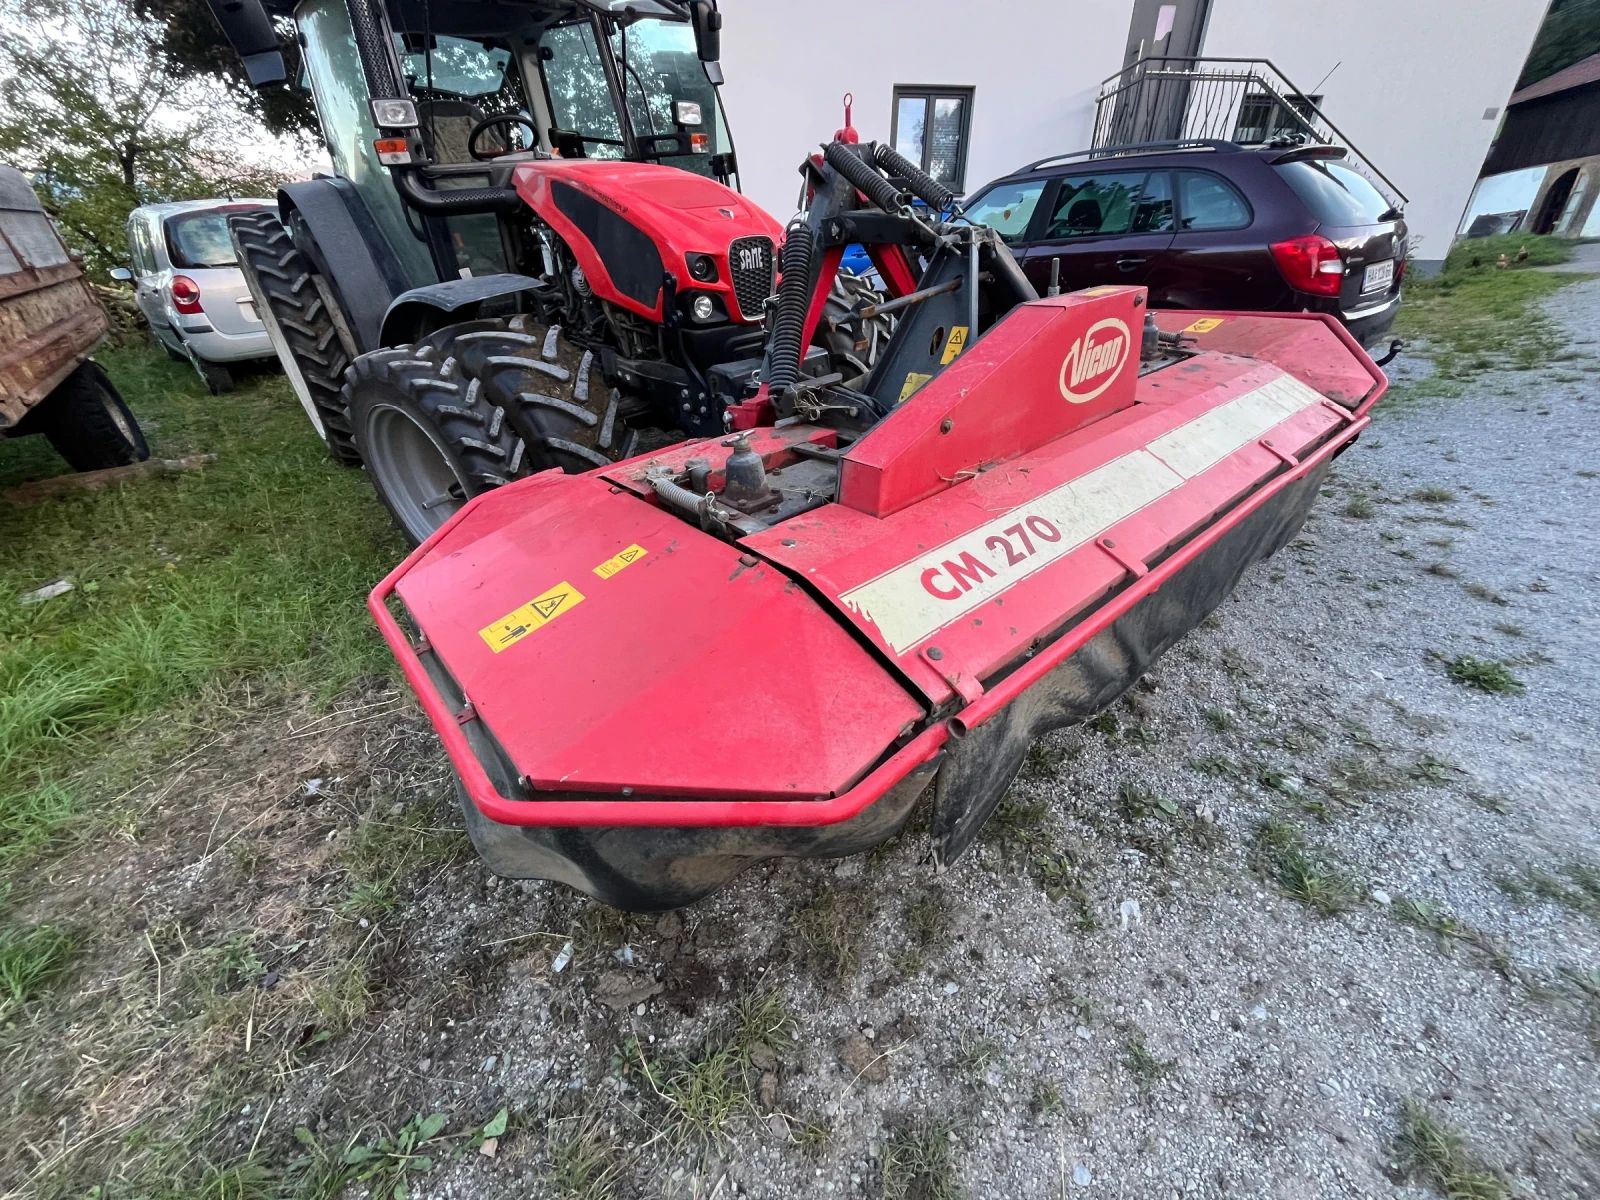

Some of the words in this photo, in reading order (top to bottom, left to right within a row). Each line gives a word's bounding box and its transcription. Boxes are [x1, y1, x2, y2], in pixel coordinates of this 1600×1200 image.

[740, 247, 763, 270] SAME
[1070, 335, 1123, 388] Vicon
[920, 551, 997, 600] CM
[985, 515, 1062, 567] 270
